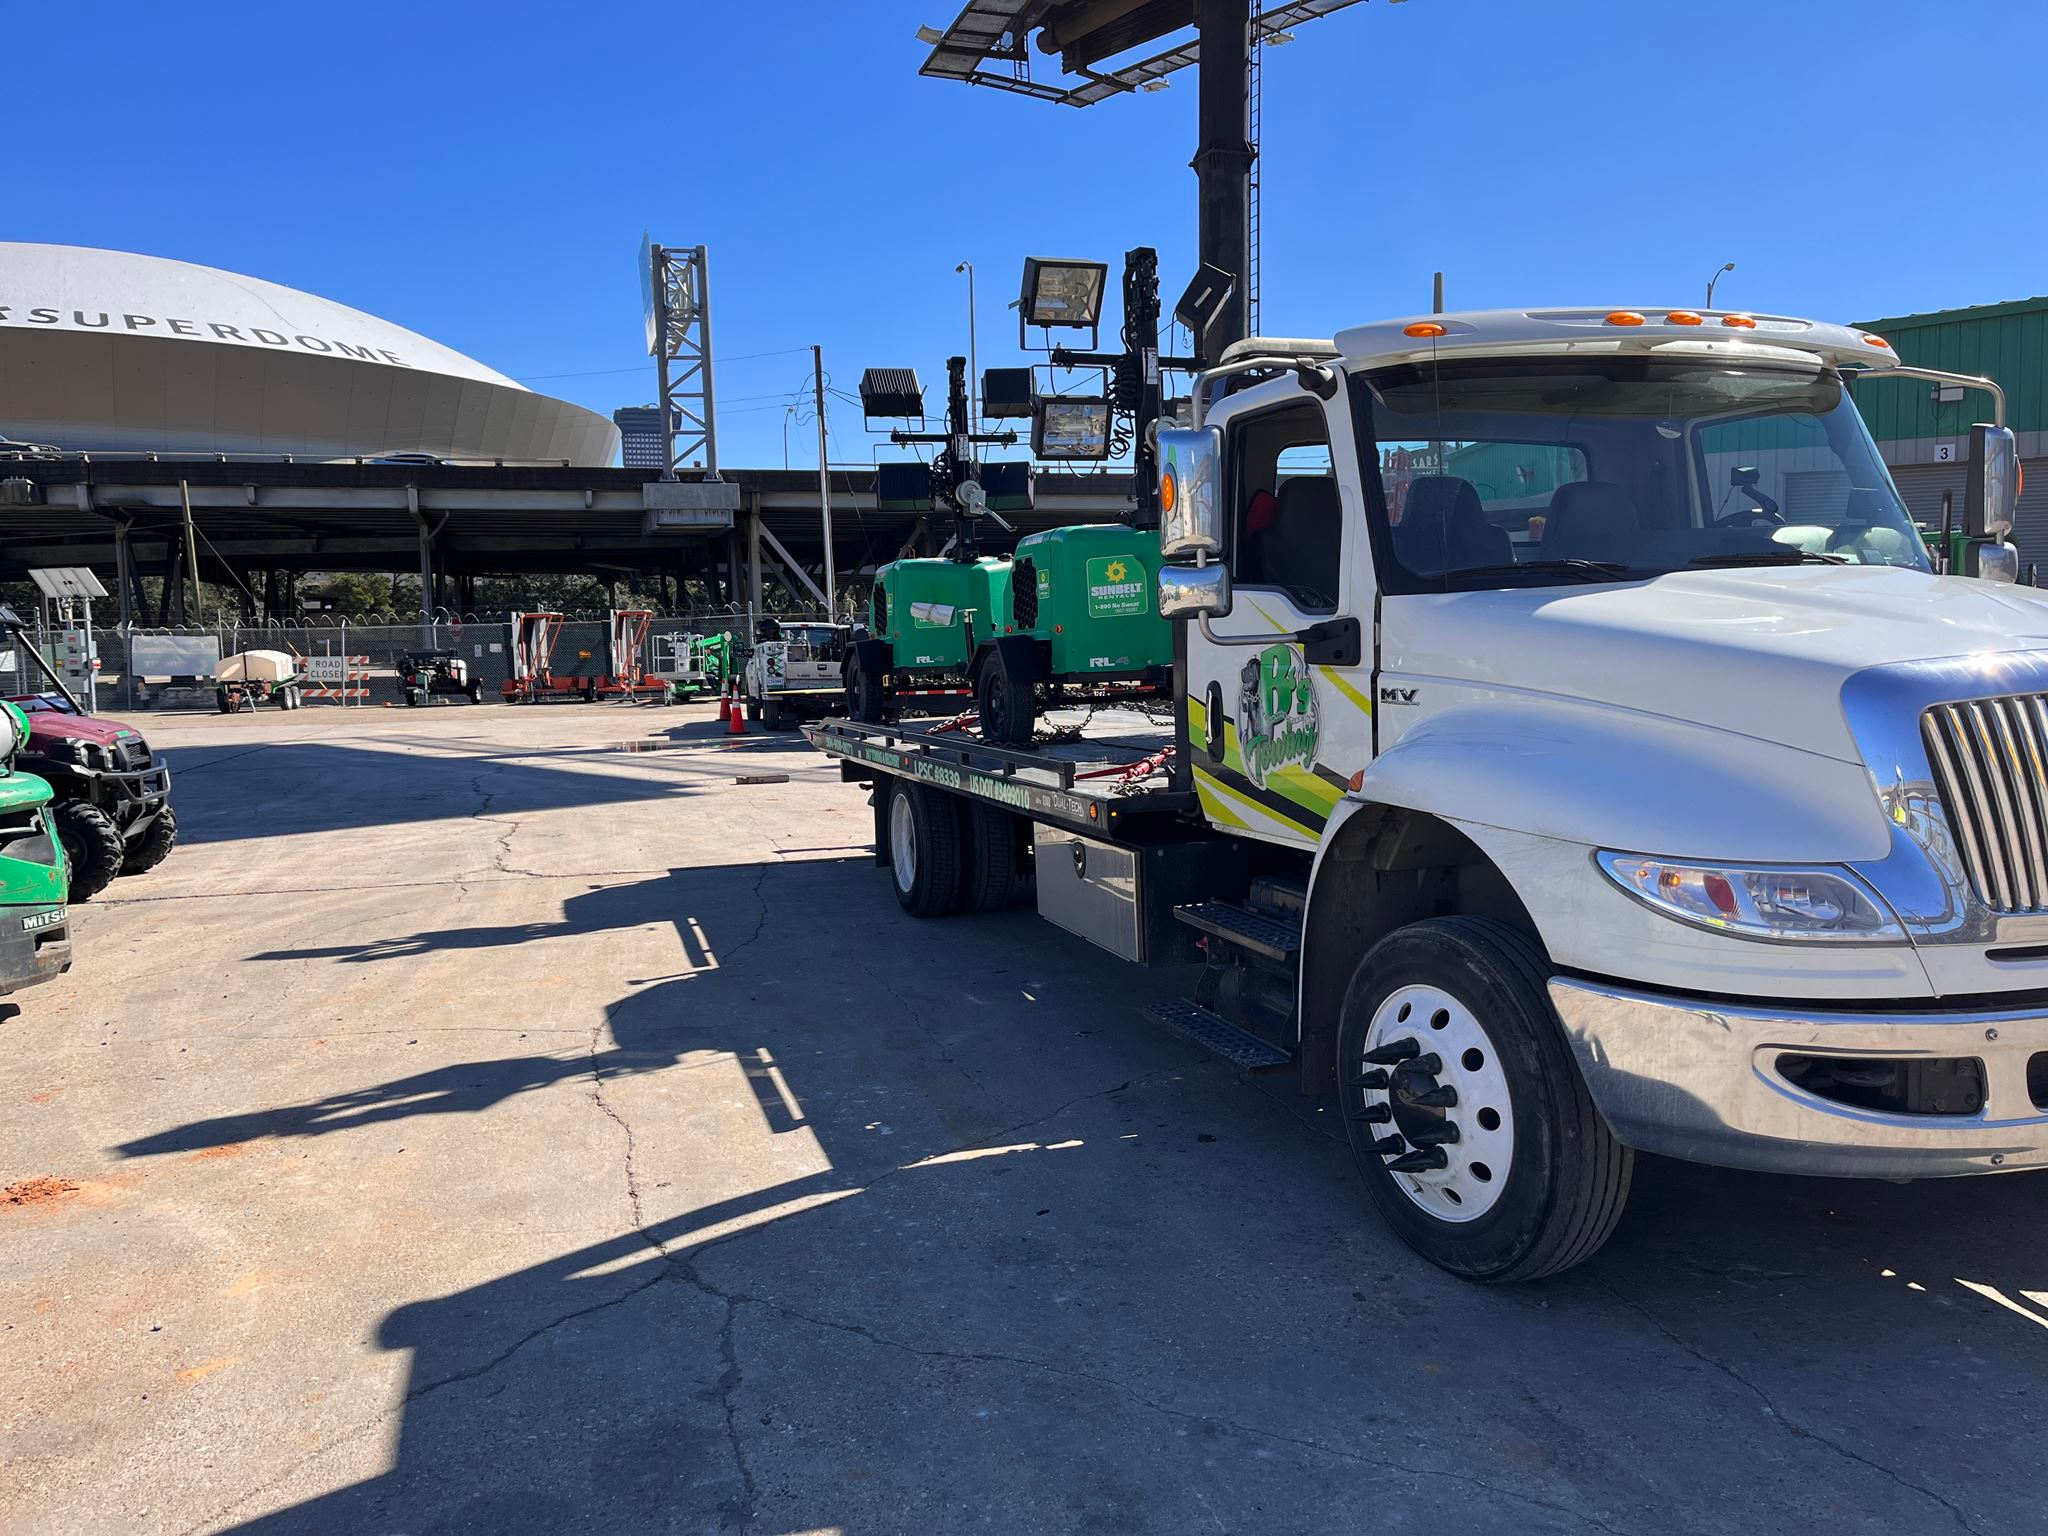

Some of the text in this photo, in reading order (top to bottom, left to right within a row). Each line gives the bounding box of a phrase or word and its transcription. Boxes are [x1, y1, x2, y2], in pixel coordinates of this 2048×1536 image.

[28, 307, 412, 367] SUPERDOME
[1412, 453, 1438, 468] SARS
[1940, 447, 1949, 460] 3
[1091, 583, 1143, 597] SUNBELT
[315, 660, 341, 668] ROAD
[1380, 687, 1420, 702] MV
[914, 760, 960, 789] LPSC #8339
[22, 908, 68, 929] MITSU
